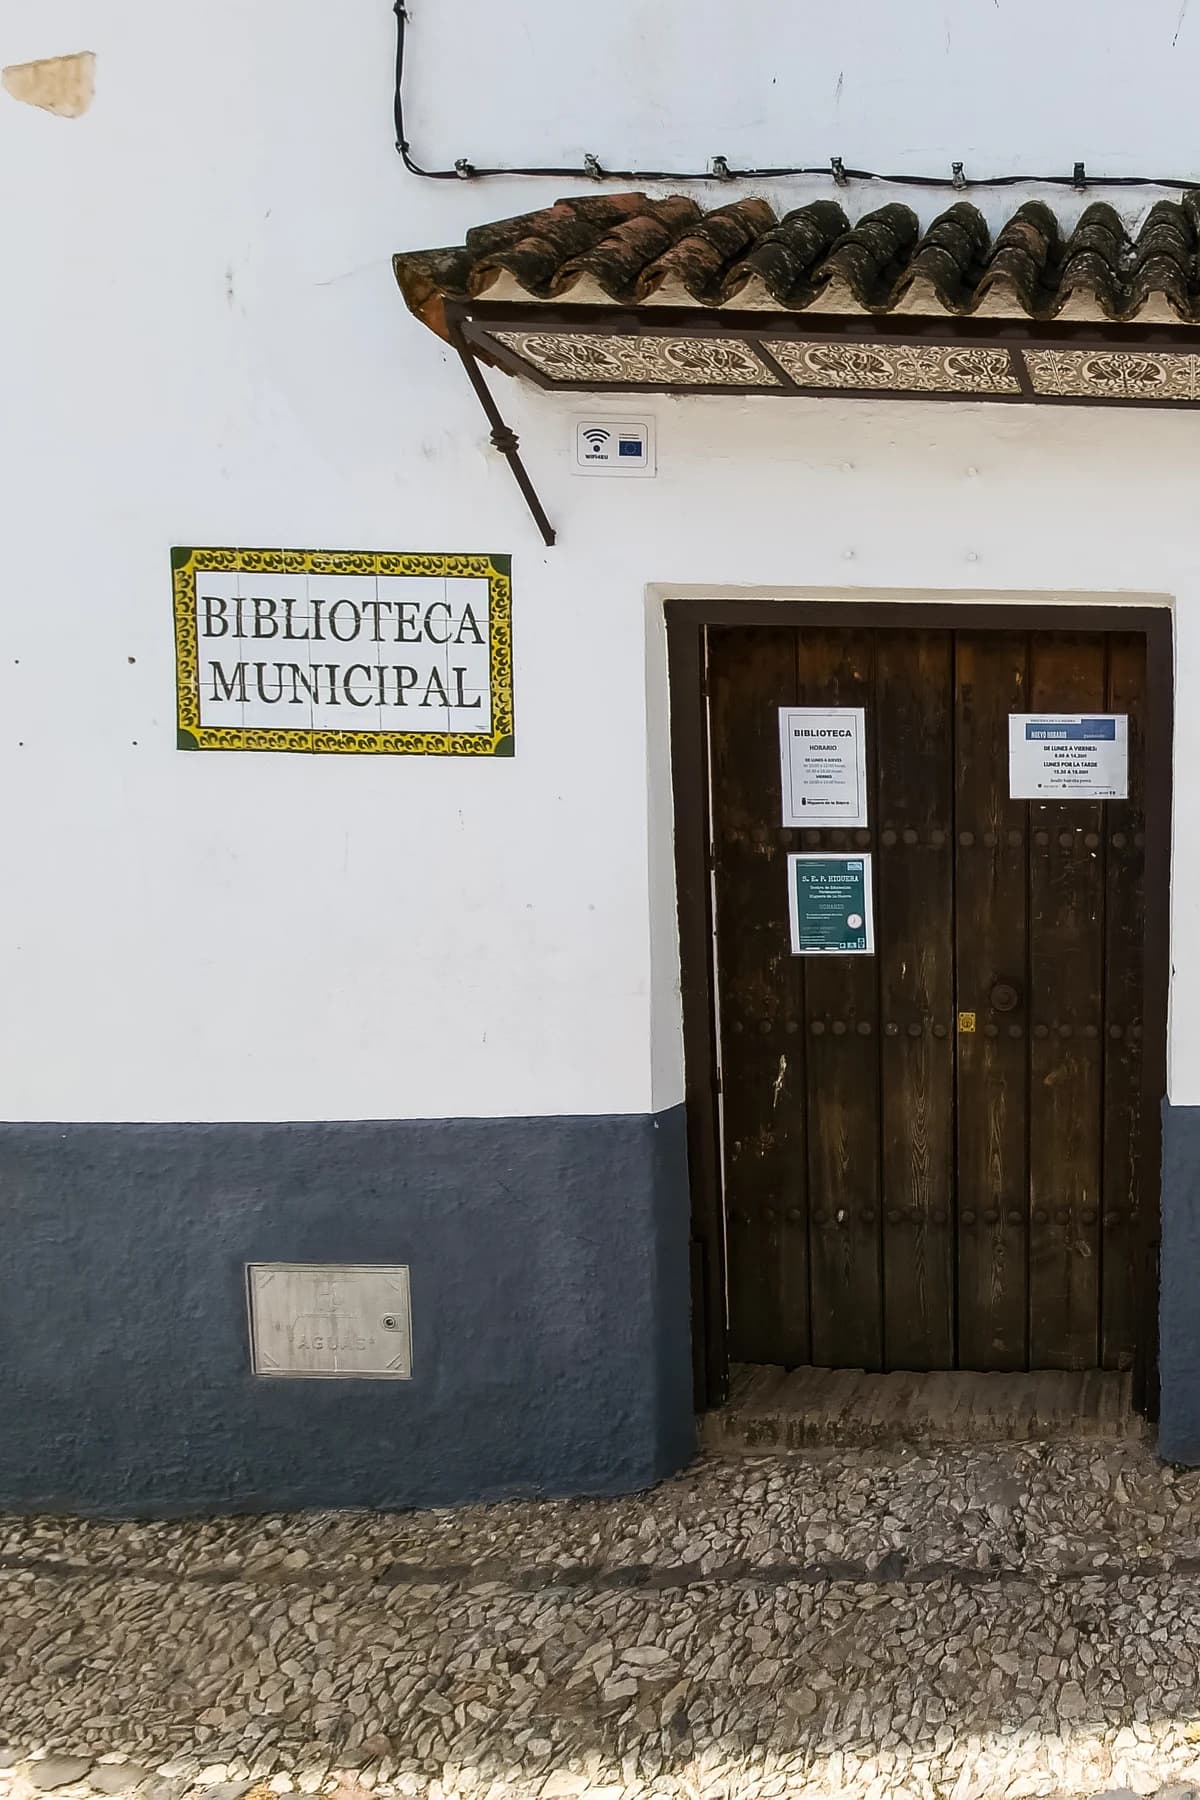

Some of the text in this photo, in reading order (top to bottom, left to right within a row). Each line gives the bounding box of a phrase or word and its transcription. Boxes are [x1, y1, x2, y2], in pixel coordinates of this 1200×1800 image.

[201, 596, 486, 645] BIBLIOTECA
[208, 661, 481, 708] MUNICIPAL
[794, 730, 852, 738] BIBLIOTECA
